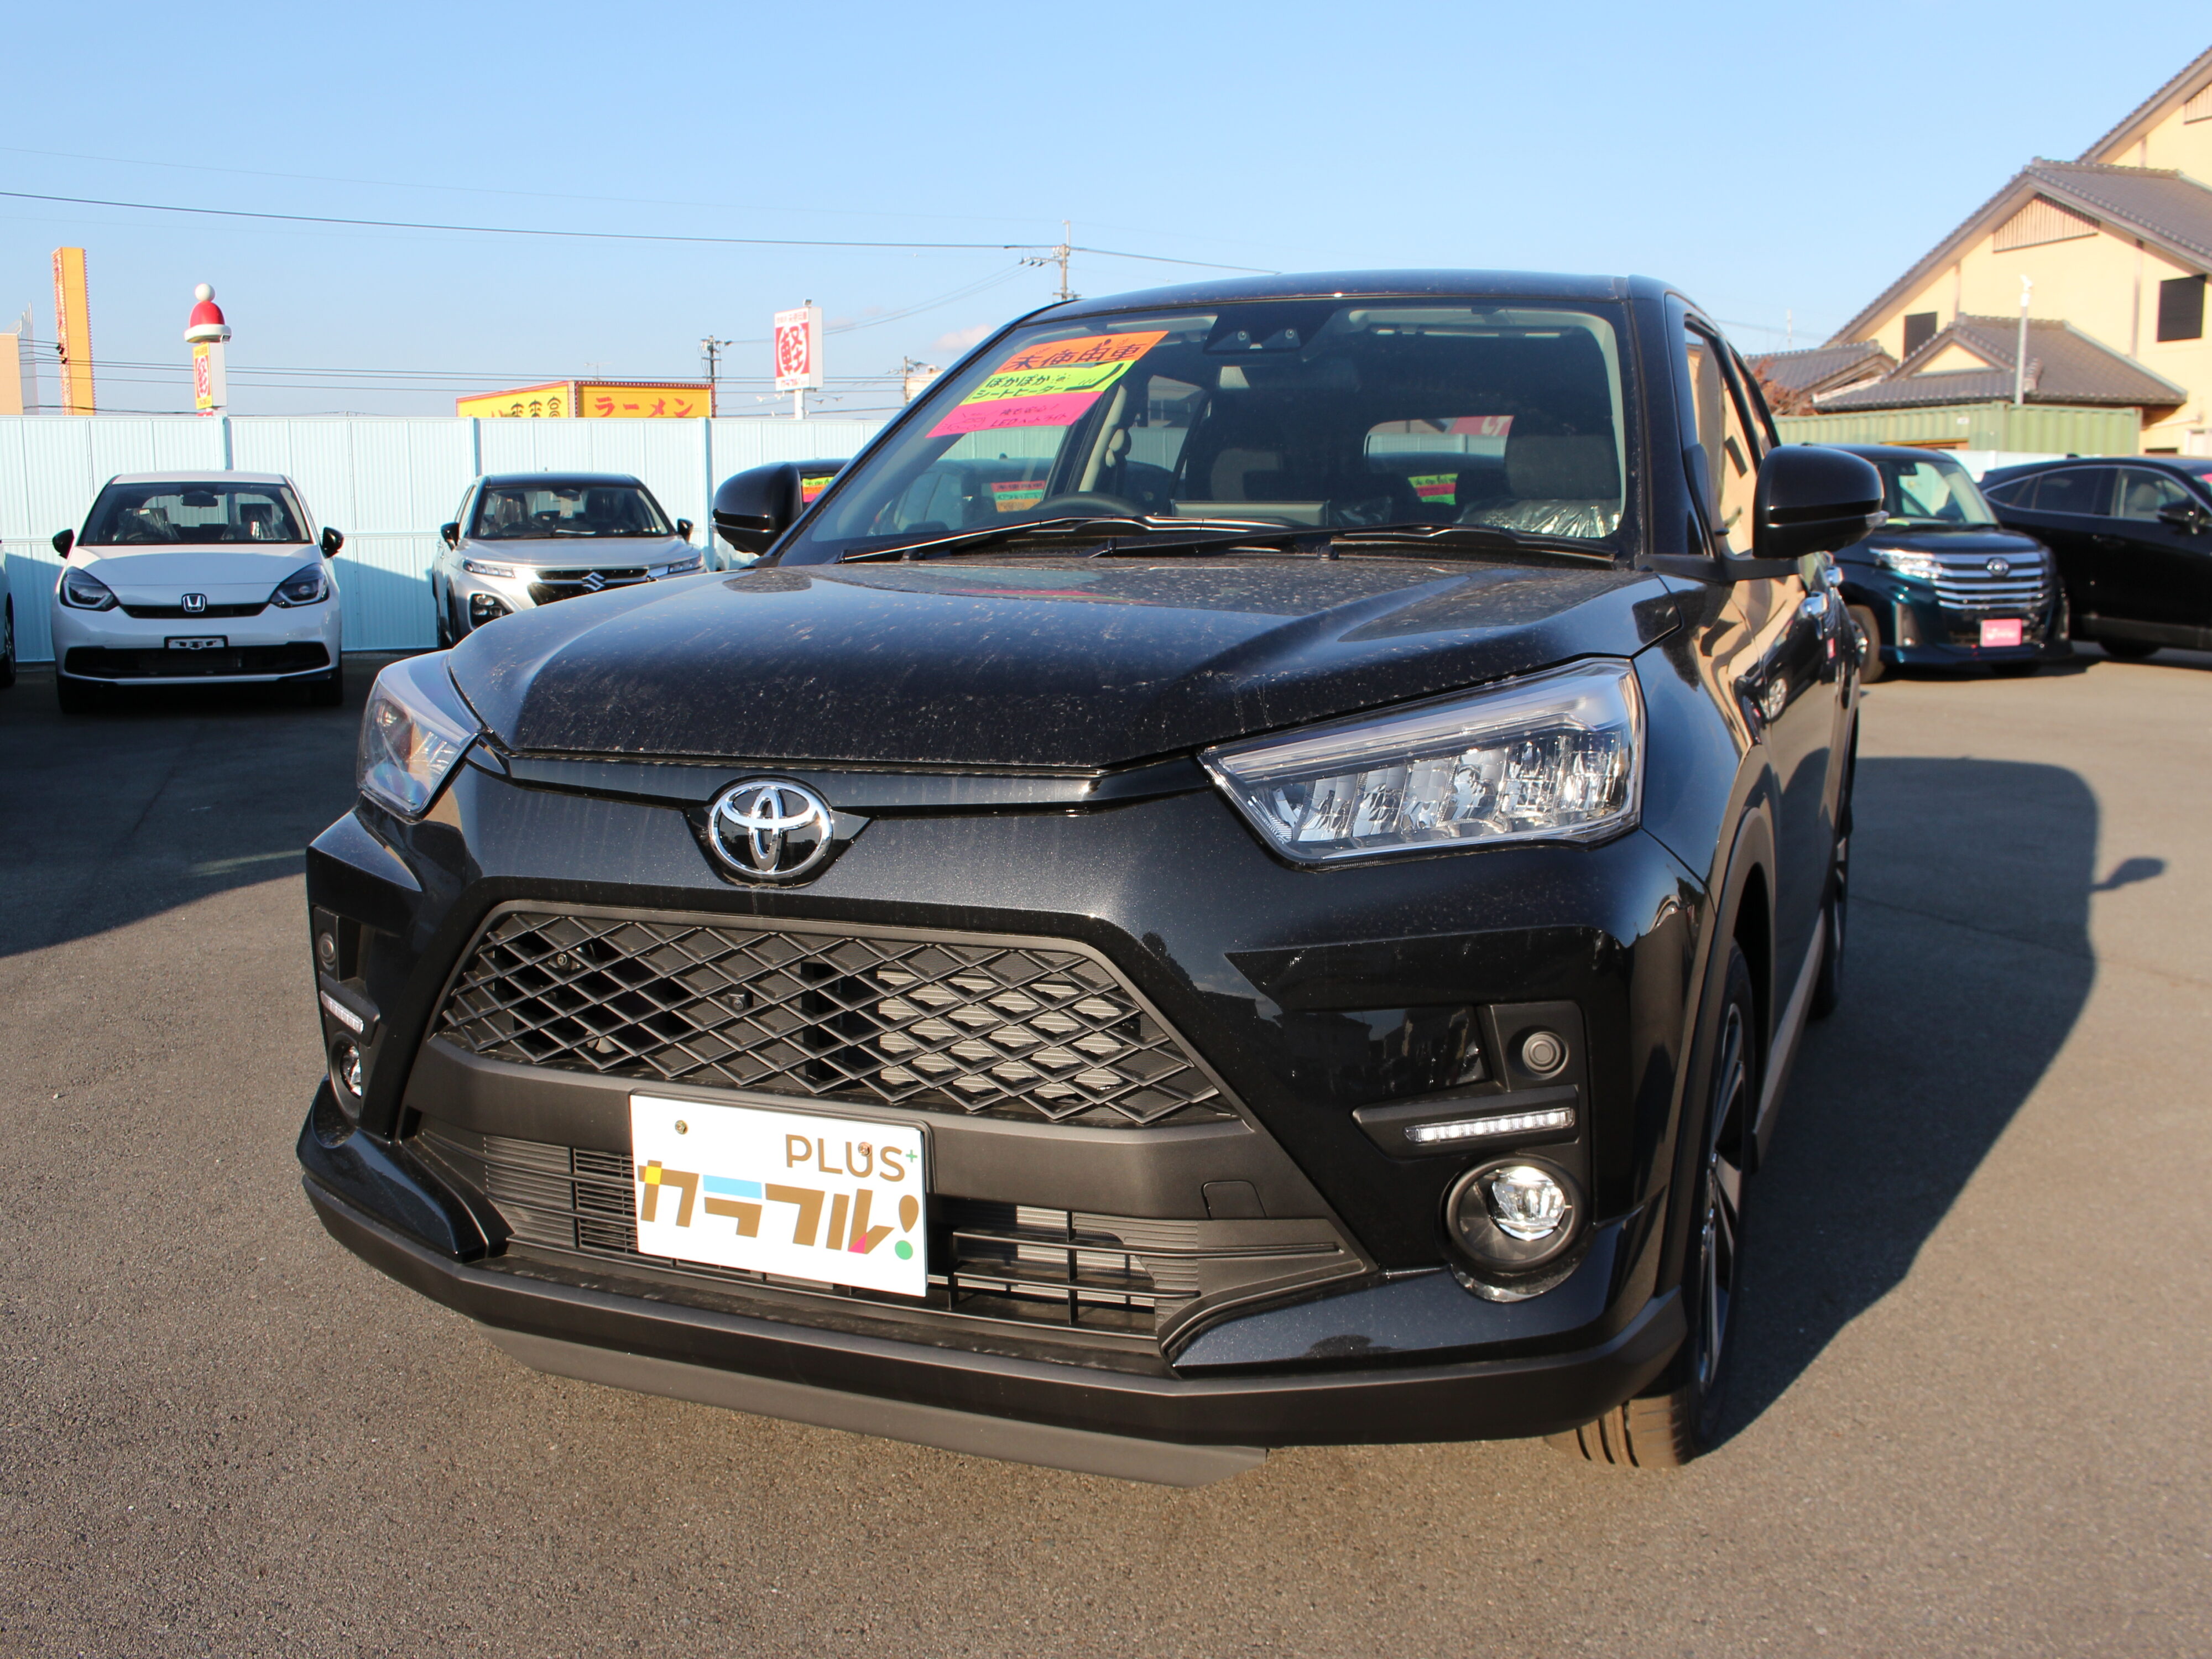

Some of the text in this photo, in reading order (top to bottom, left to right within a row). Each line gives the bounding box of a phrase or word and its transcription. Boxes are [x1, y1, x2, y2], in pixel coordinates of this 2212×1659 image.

[780, 326, 803, 375] 軽
[986, 374, 1050, 388] ぽかぽか
[972, 385, 1063, 399] シートヒーター
[594, 397, 693, 418] ラーメン
